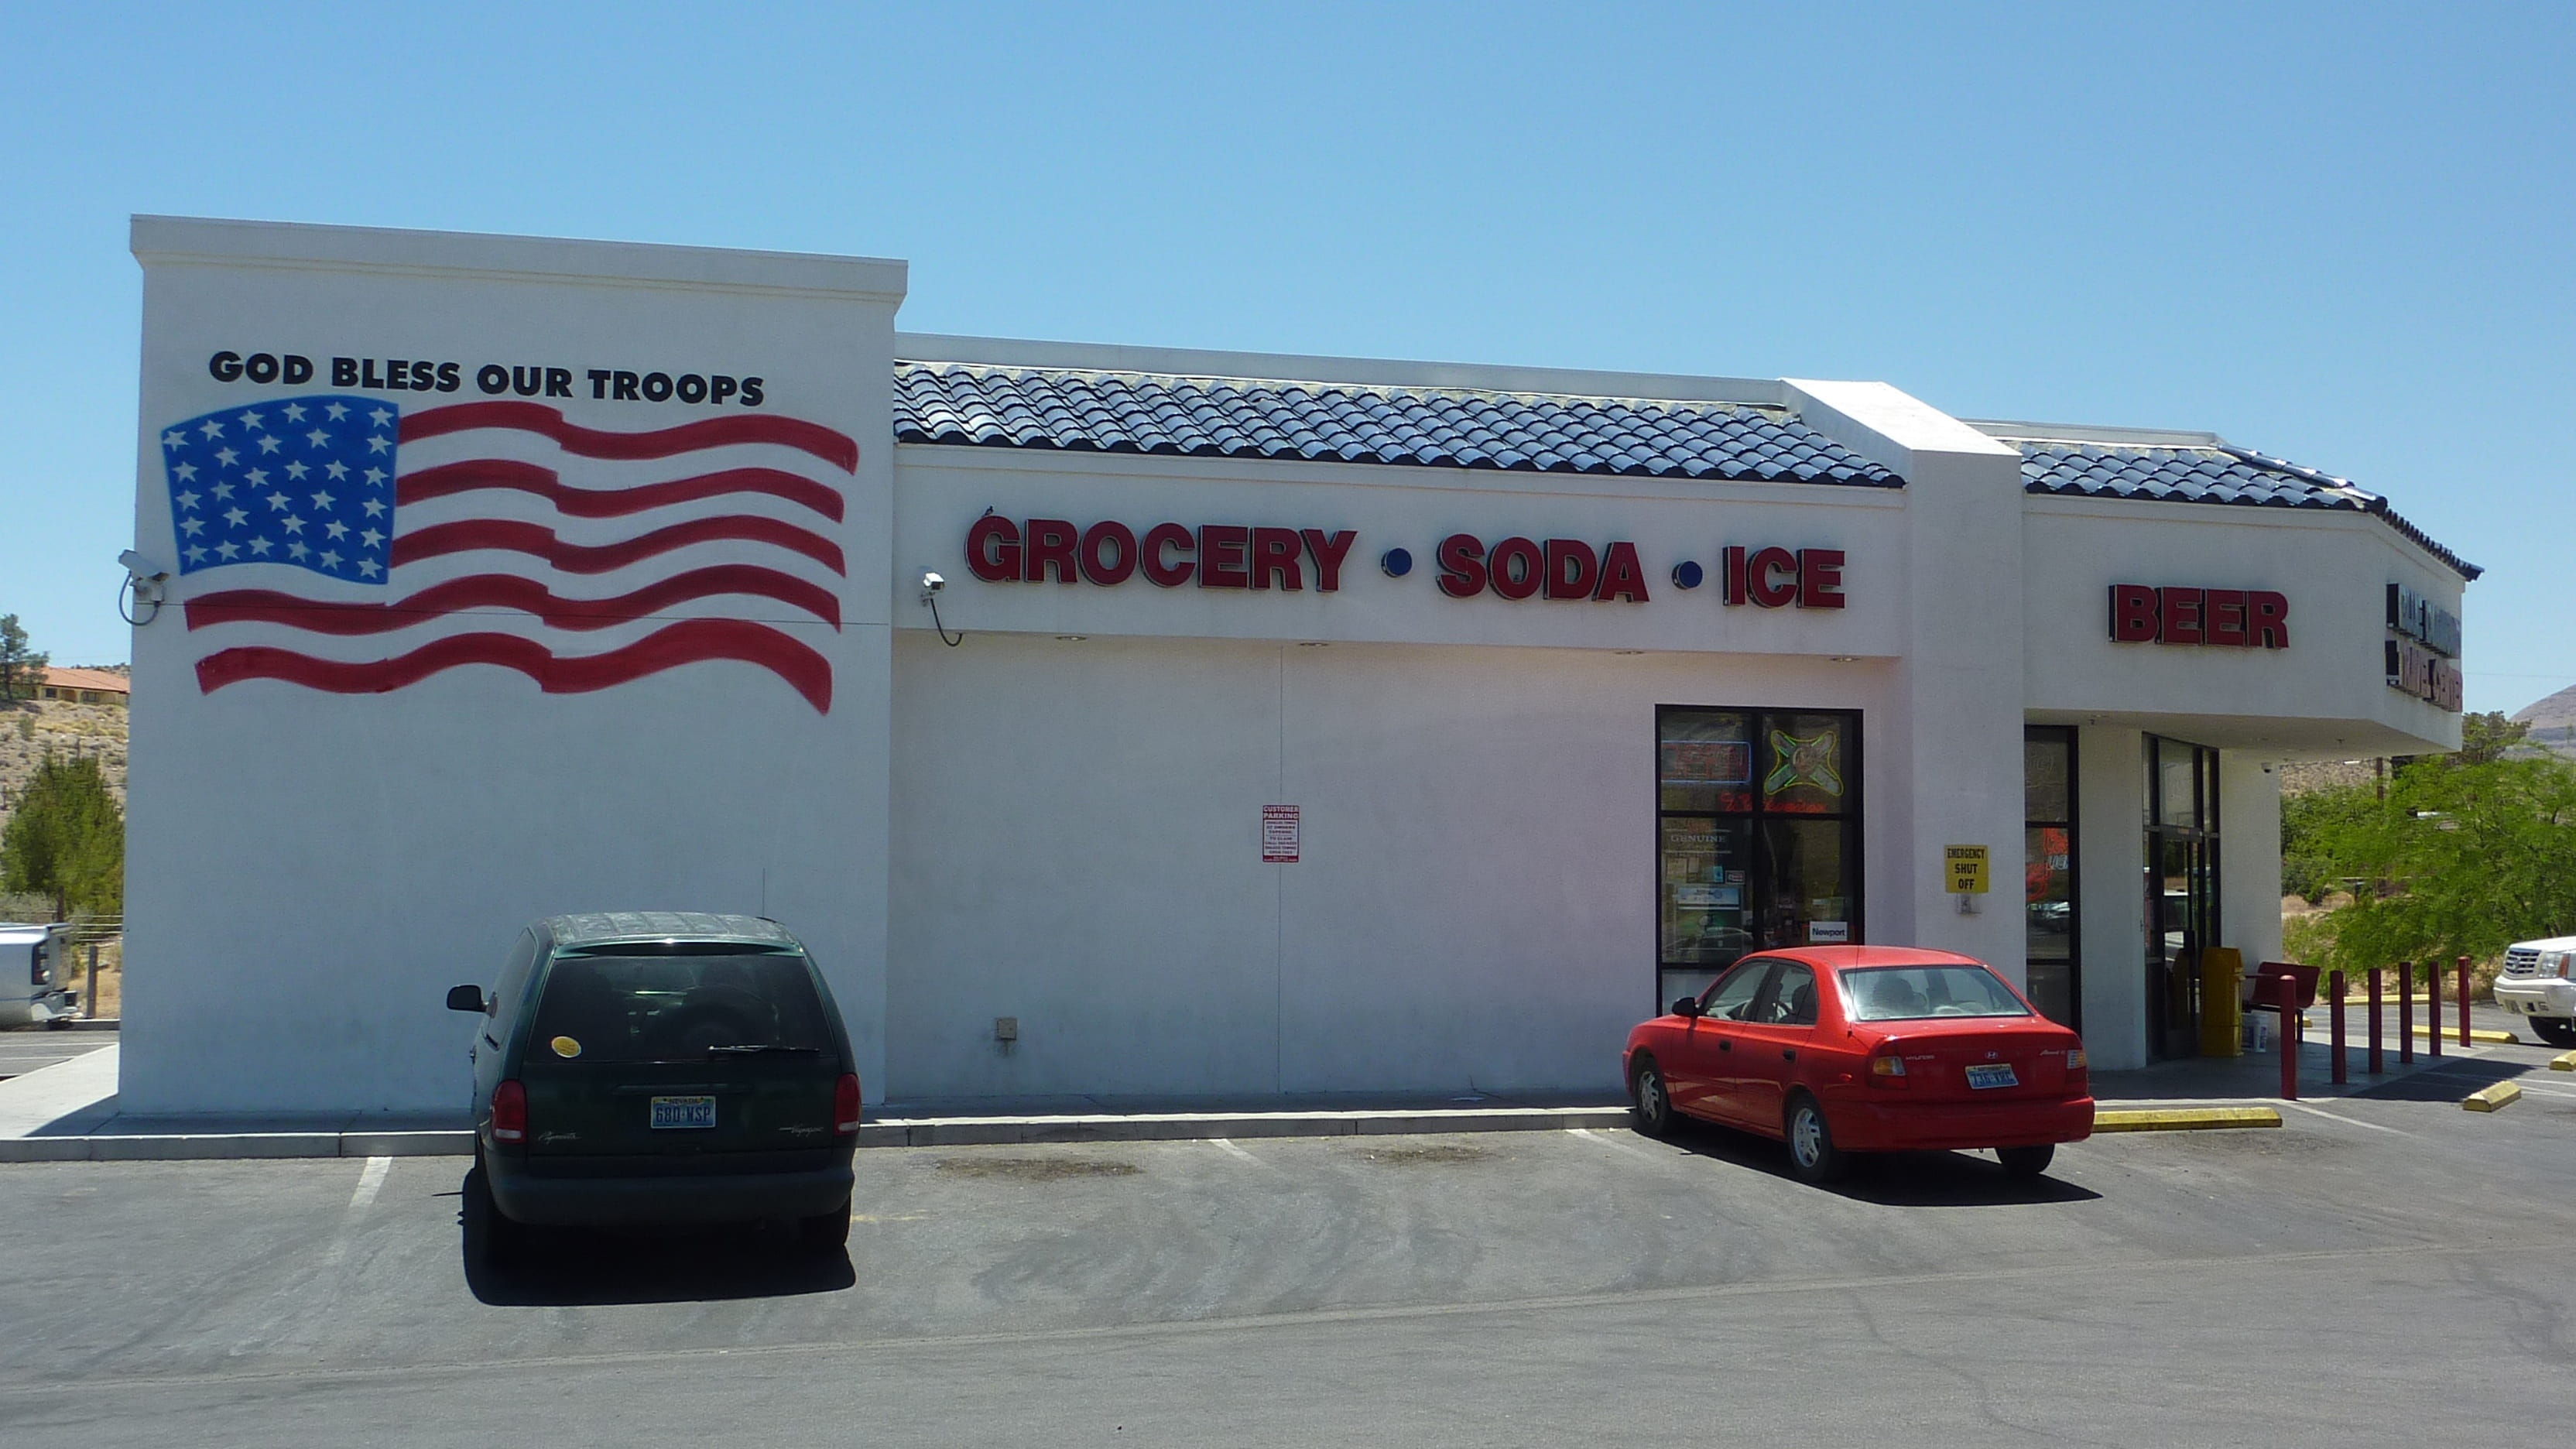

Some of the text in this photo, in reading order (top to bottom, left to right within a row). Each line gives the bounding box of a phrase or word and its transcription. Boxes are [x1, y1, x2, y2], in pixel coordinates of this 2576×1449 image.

[209, 351, 764, 406] GOD BLESS OUR TROOPS
[965, 515, 1846, 610] GROCERY SODA ICE
[2108, 584, 2290, 650] BEER
[1670, 834, 1726, 843] GENUINE
[1947, 848, 1985, 859] EMERGENCY
[1954, 863, 1978, 875] SHUT
[1958, 878, 1975, 890] OFF
[1812, 927, 1846, 937] Newport
